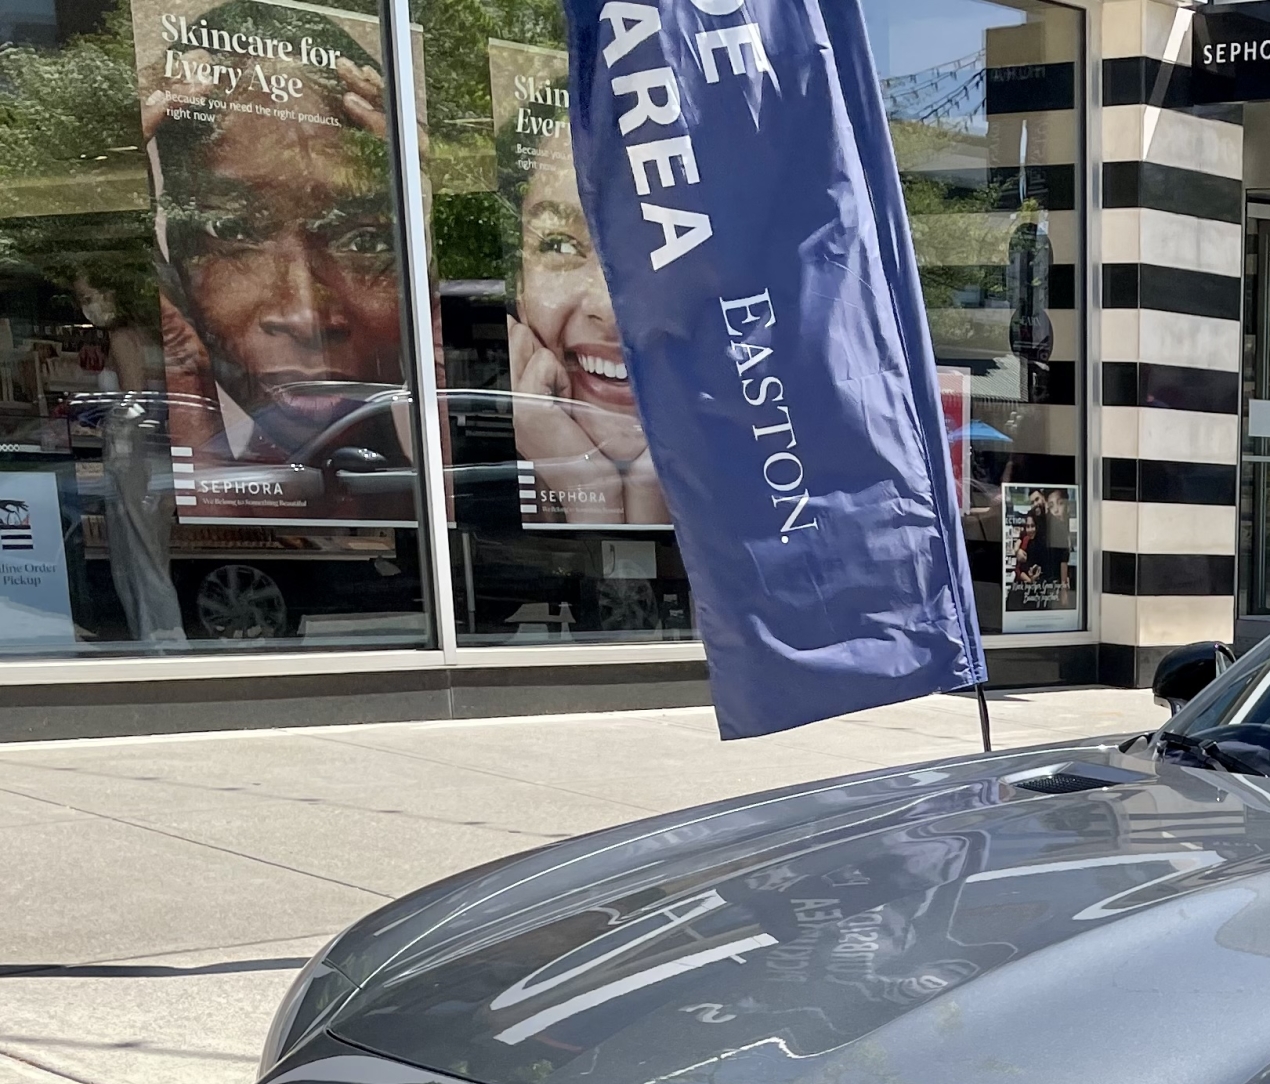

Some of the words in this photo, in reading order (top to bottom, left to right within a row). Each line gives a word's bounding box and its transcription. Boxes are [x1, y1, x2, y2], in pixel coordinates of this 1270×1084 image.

[161, 13, 293, 61] Skincare
[300, 37, 341, 69] for
[164, 49, 242, 95] Every
[249, 64, 303, 103] Age
[514, 74, 570, 108] Skin
[165, 91, 206, 106] Because
[208, 100, 226, 111] you
[230, 102, 253, 113] need
[255, 105, 271, 116] the
[274, 109, 296, 121] right
[166, 107, 191, 121] right
[194, 113, 216, 123] now
[516, 107, 571, 139] Ever
[600, 2, 713, 271] AREA
[200, 480, 283, 495] SEPHORA
[540, 490, 606, 502] SEPHORA
[0, 563, 23, 574] line
[24, 563, 57, 573] Order
[3, 575, 41, 587] Pickup
